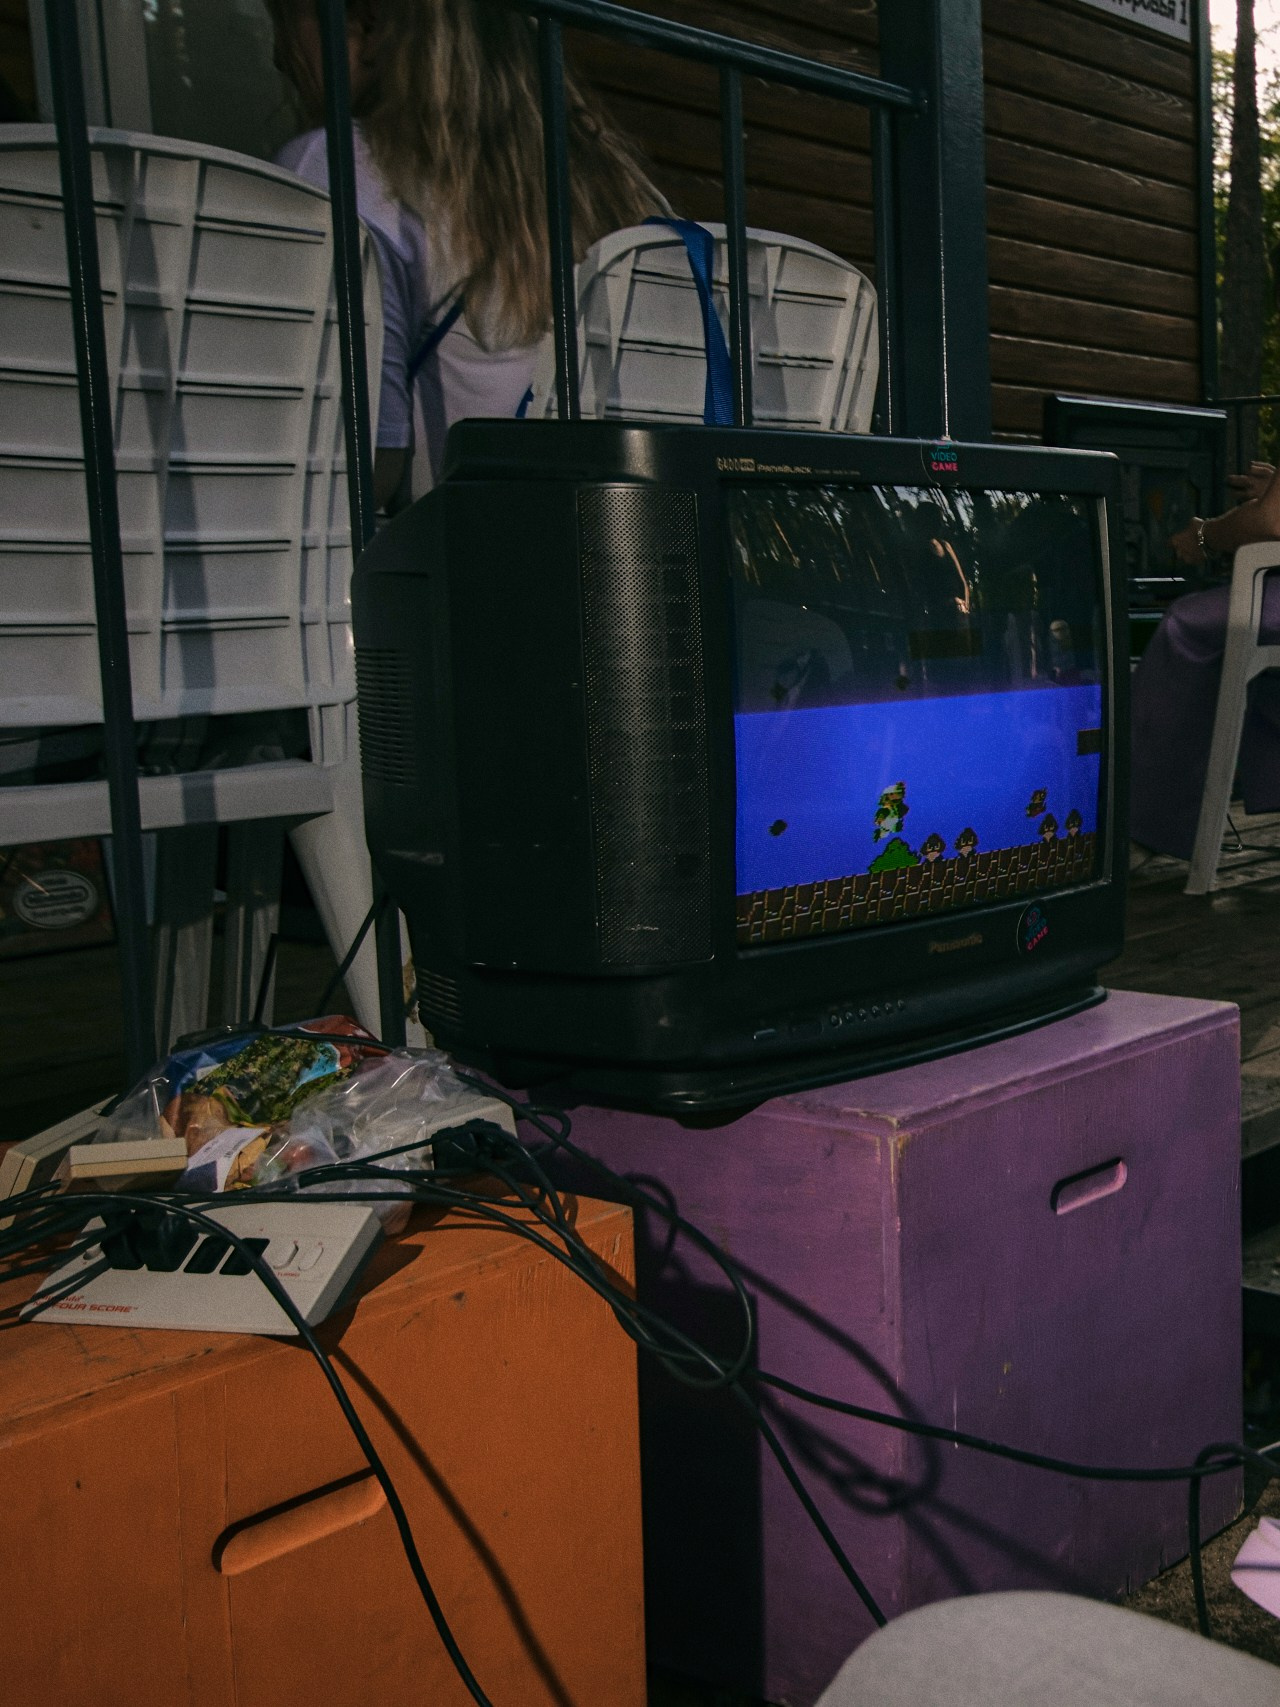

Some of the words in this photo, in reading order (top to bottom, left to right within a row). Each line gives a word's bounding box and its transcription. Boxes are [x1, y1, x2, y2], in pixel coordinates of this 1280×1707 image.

[930, 451, 958, 462] VIDEO
[931, 461, 959, 472] GAME
[928, 932, 982, 954] Panasonic
[1026, 926, 1049, 951] GAME
[89, 1304, 131, 1313] SCORE
